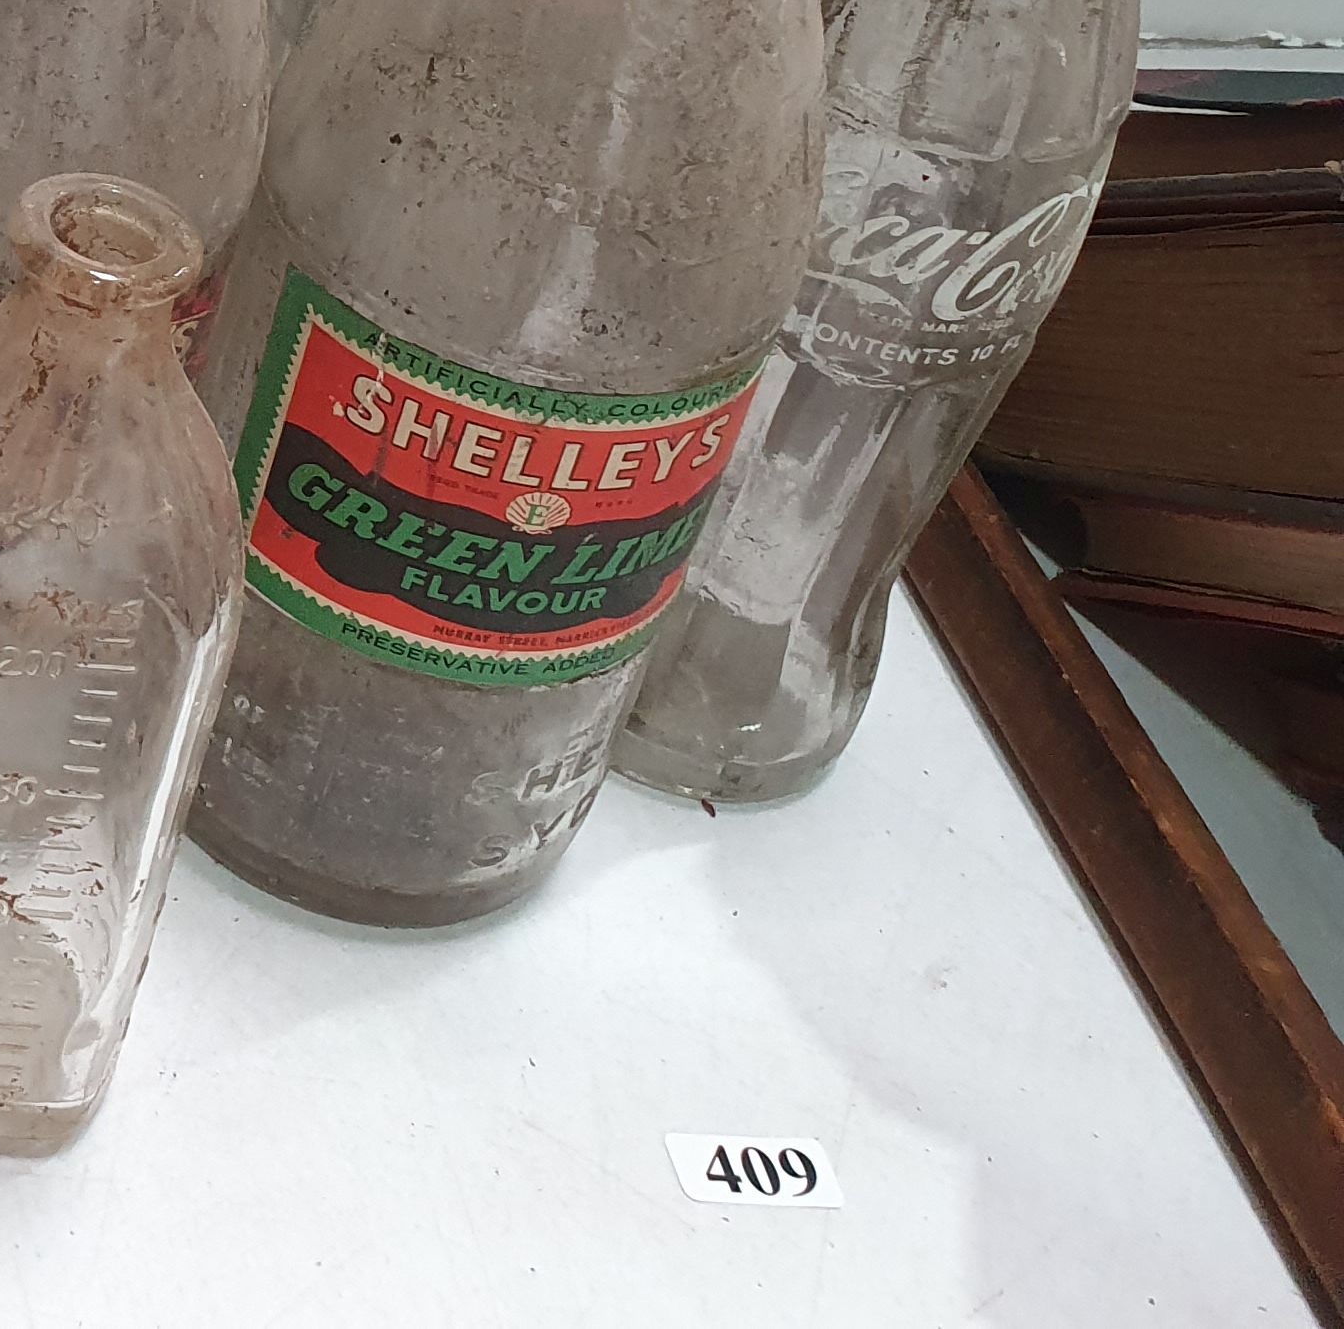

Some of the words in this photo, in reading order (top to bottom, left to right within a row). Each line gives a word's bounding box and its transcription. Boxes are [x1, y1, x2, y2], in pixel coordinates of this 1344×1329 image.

[364, 329, 591, 419] ARTIFICIALLY
[969, 342, 997, 364] 10
[286, 463, 557, 584] GREEN
[399, 565, 608, 616] FLAVOUR
[340, 621, 531, 677] PRESERVATIVE
[542, 646, 617, 675] ADDED
[705, 1144, 818, 1198] 409
